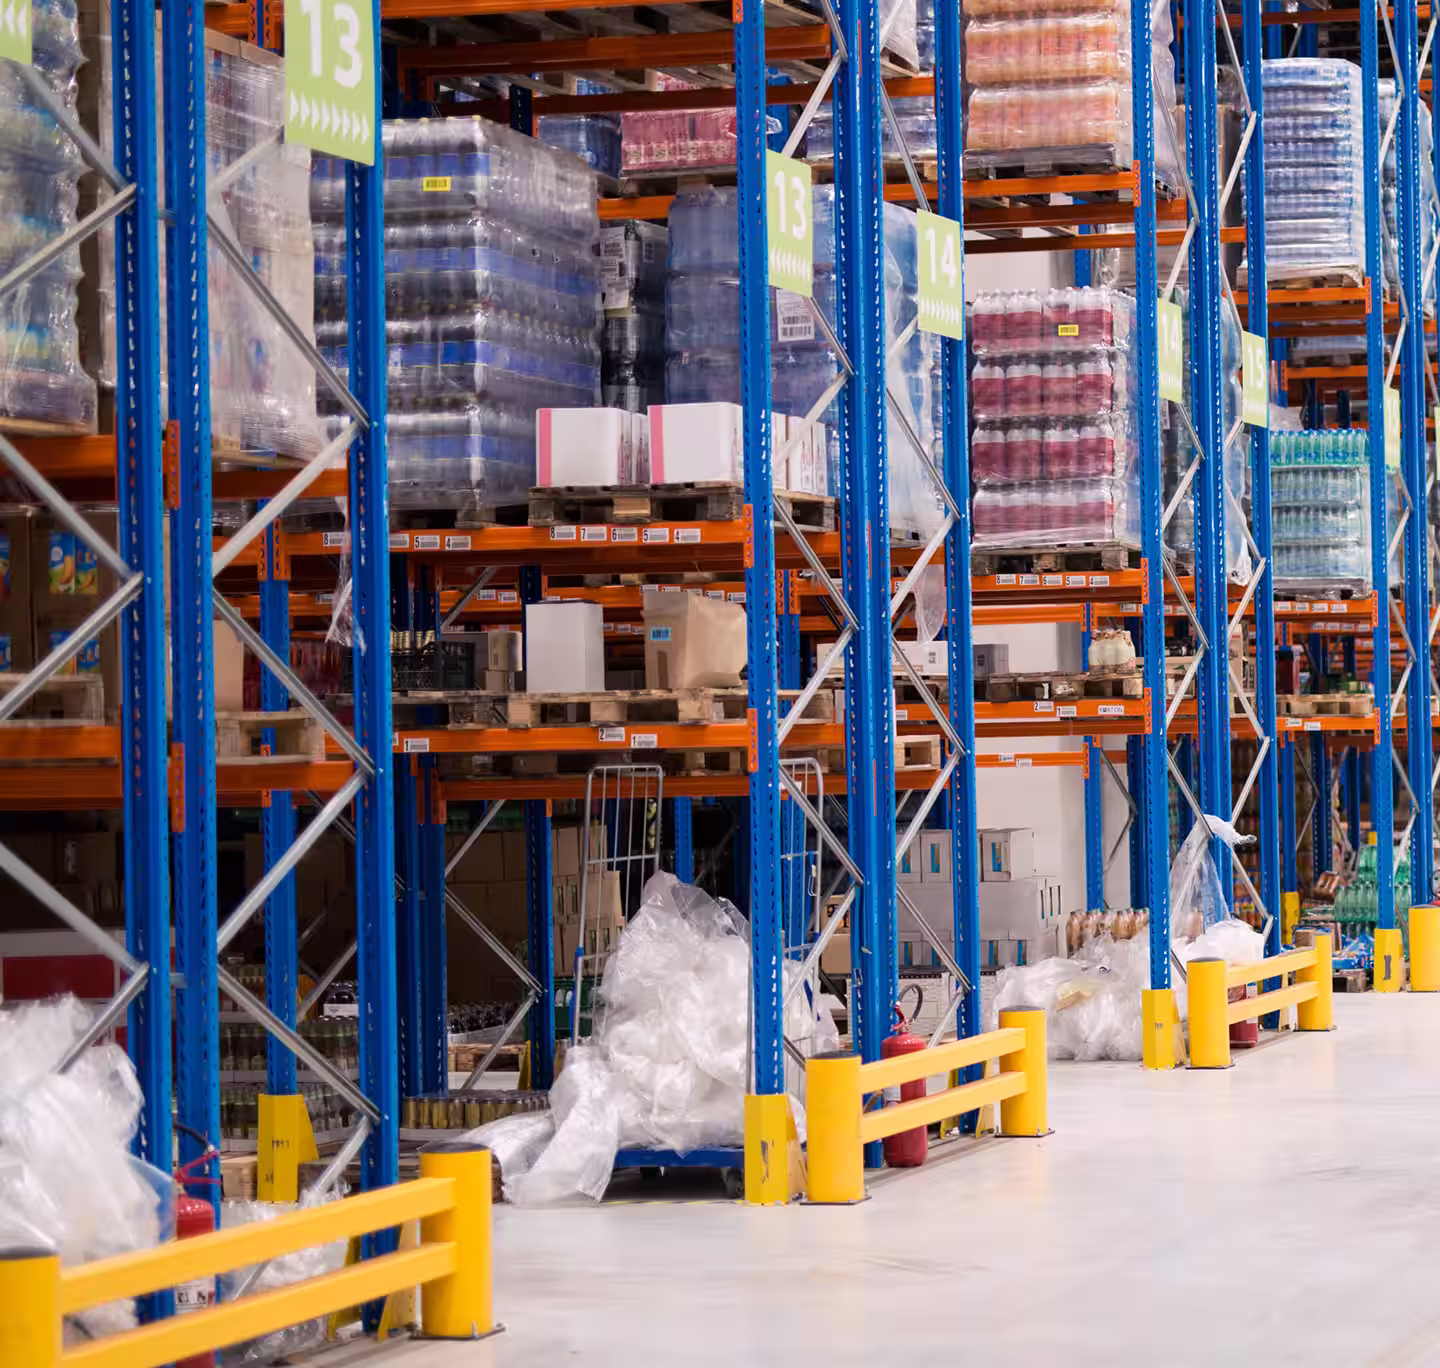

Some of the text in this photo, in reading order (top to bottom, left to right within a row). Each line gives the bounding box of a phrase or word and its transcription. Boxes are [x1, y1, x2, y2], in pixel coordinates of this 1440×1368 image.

[301, 0, 362, 89] 13
[774, 170, 807, 241] 13
[925, 227, 957, 290] 14
[1161, 312, 1180, 361] 14
[1247, 344, 1265, 389] 15
